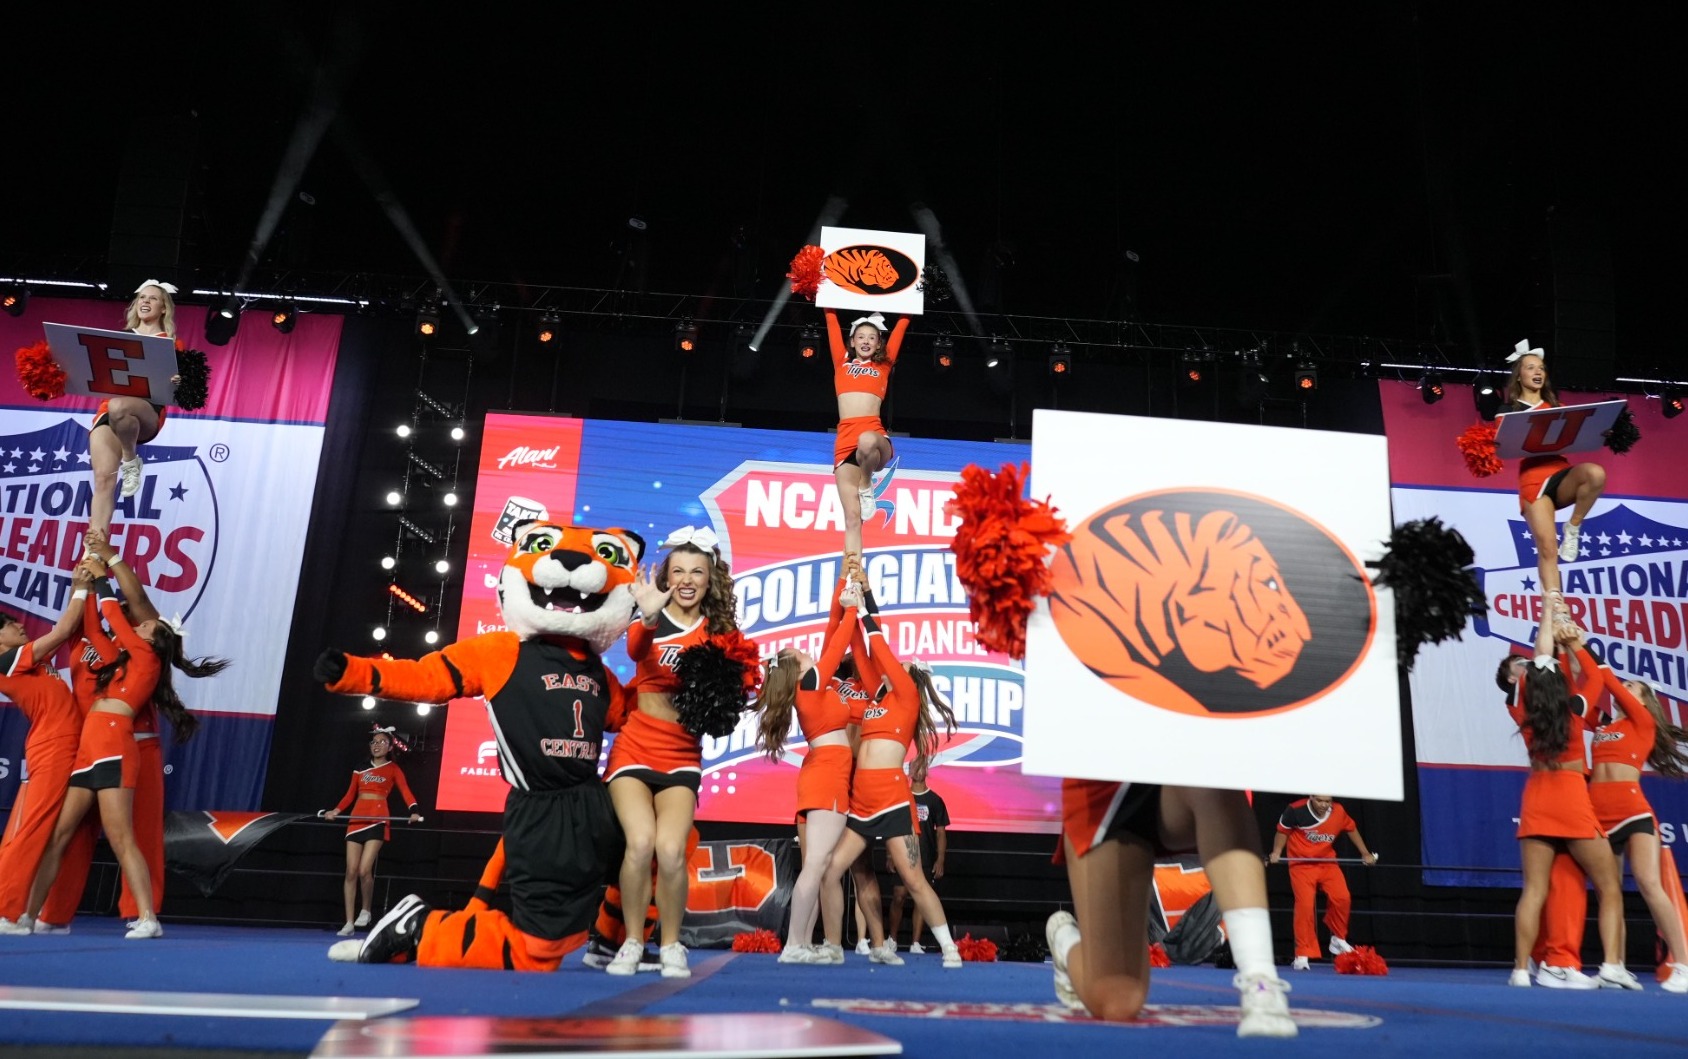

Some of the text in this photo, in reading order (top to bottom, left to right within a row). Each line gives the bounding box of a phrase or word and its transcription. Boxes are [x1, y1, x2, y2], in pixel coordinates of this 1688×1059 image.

[77, 333, 151, 399] E
[846, 363, 880, 379] Tigers
[1522, 408, 1595, 453] U
[497, 446, 560, 469] Alani
[0, 475, 161, 520] TIOAL
[745, 480, 964, 537] NCA ND
[0, 516, 205, 593] EADRS
[733, 553, 968, 632] COLLGIAT
[1559, 560, 1688, 598] ATION
[1494, 594, 1688, 650] CHERLEAD
[658, 643, 684, 673] Tig
[541, 673, 600, 697] EAST
[572, 699, 585, 738] 1
[864, 706, 888, 720] ers
[460, 766, 502, 777] FABLE
